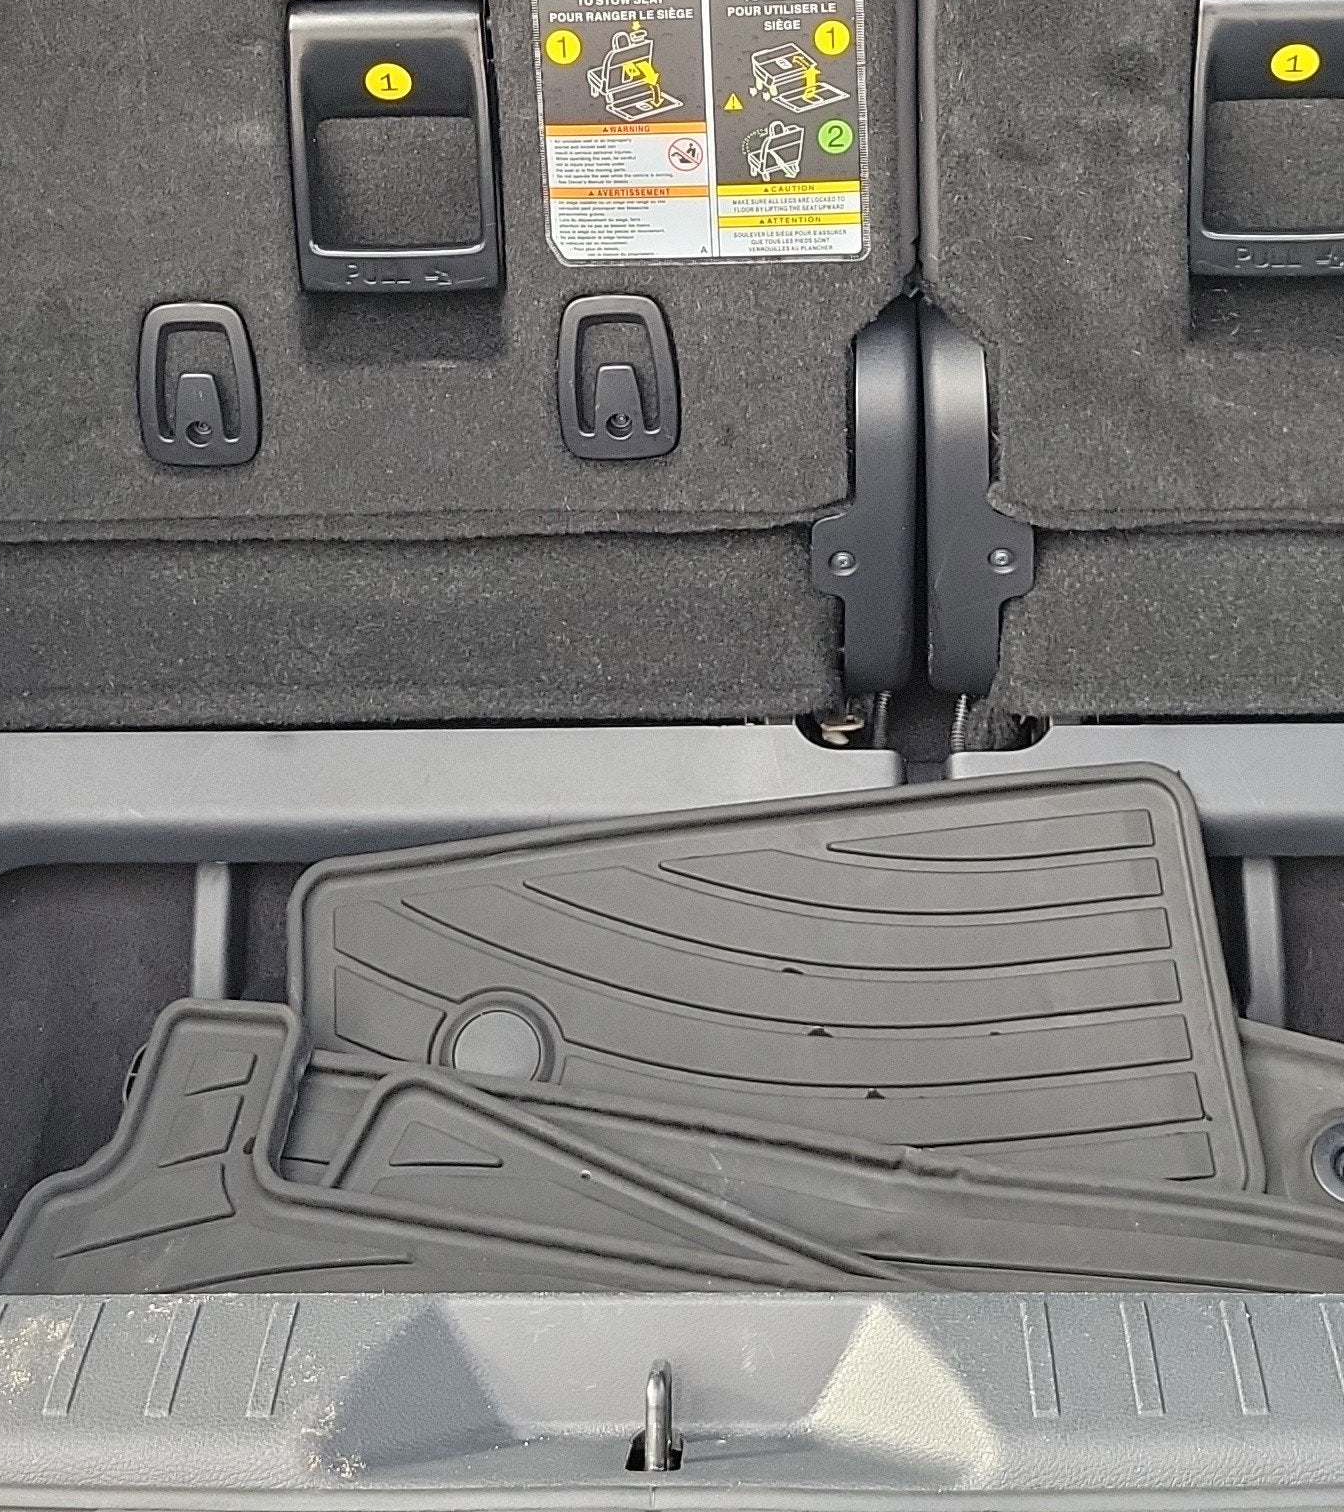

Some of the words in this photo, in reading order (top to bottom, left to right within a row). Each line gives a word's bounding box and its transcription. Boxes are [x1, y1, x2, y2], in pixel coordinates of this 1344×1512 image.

[549, 11, 583, 22] POUR
[585, 10, 637, 21] RANGER
[639, 9, 655, 20] LE
[656, 7, 693, 20] SIÈGE
[727, 6, 762, 17] POUR
[764, 3, 818, 15] UTILISER
[820, 2, 836, 13] LE
[763, 19, 801, 31] SIÈGE
[826, 26, 835, 49] 1
[557, 36, 566, 58] 1
[1284, 55, 1303, 73] 1
[381, 73, 399, 91] 1
[610, 125, 650, 133] WARNING
[828, 125, 844, 148] 2
[597, 188, 670, 197] AVERTISSEMENT
[767, 216, 821, 224] ATTENTION
[700, 246, 709, 255] A
